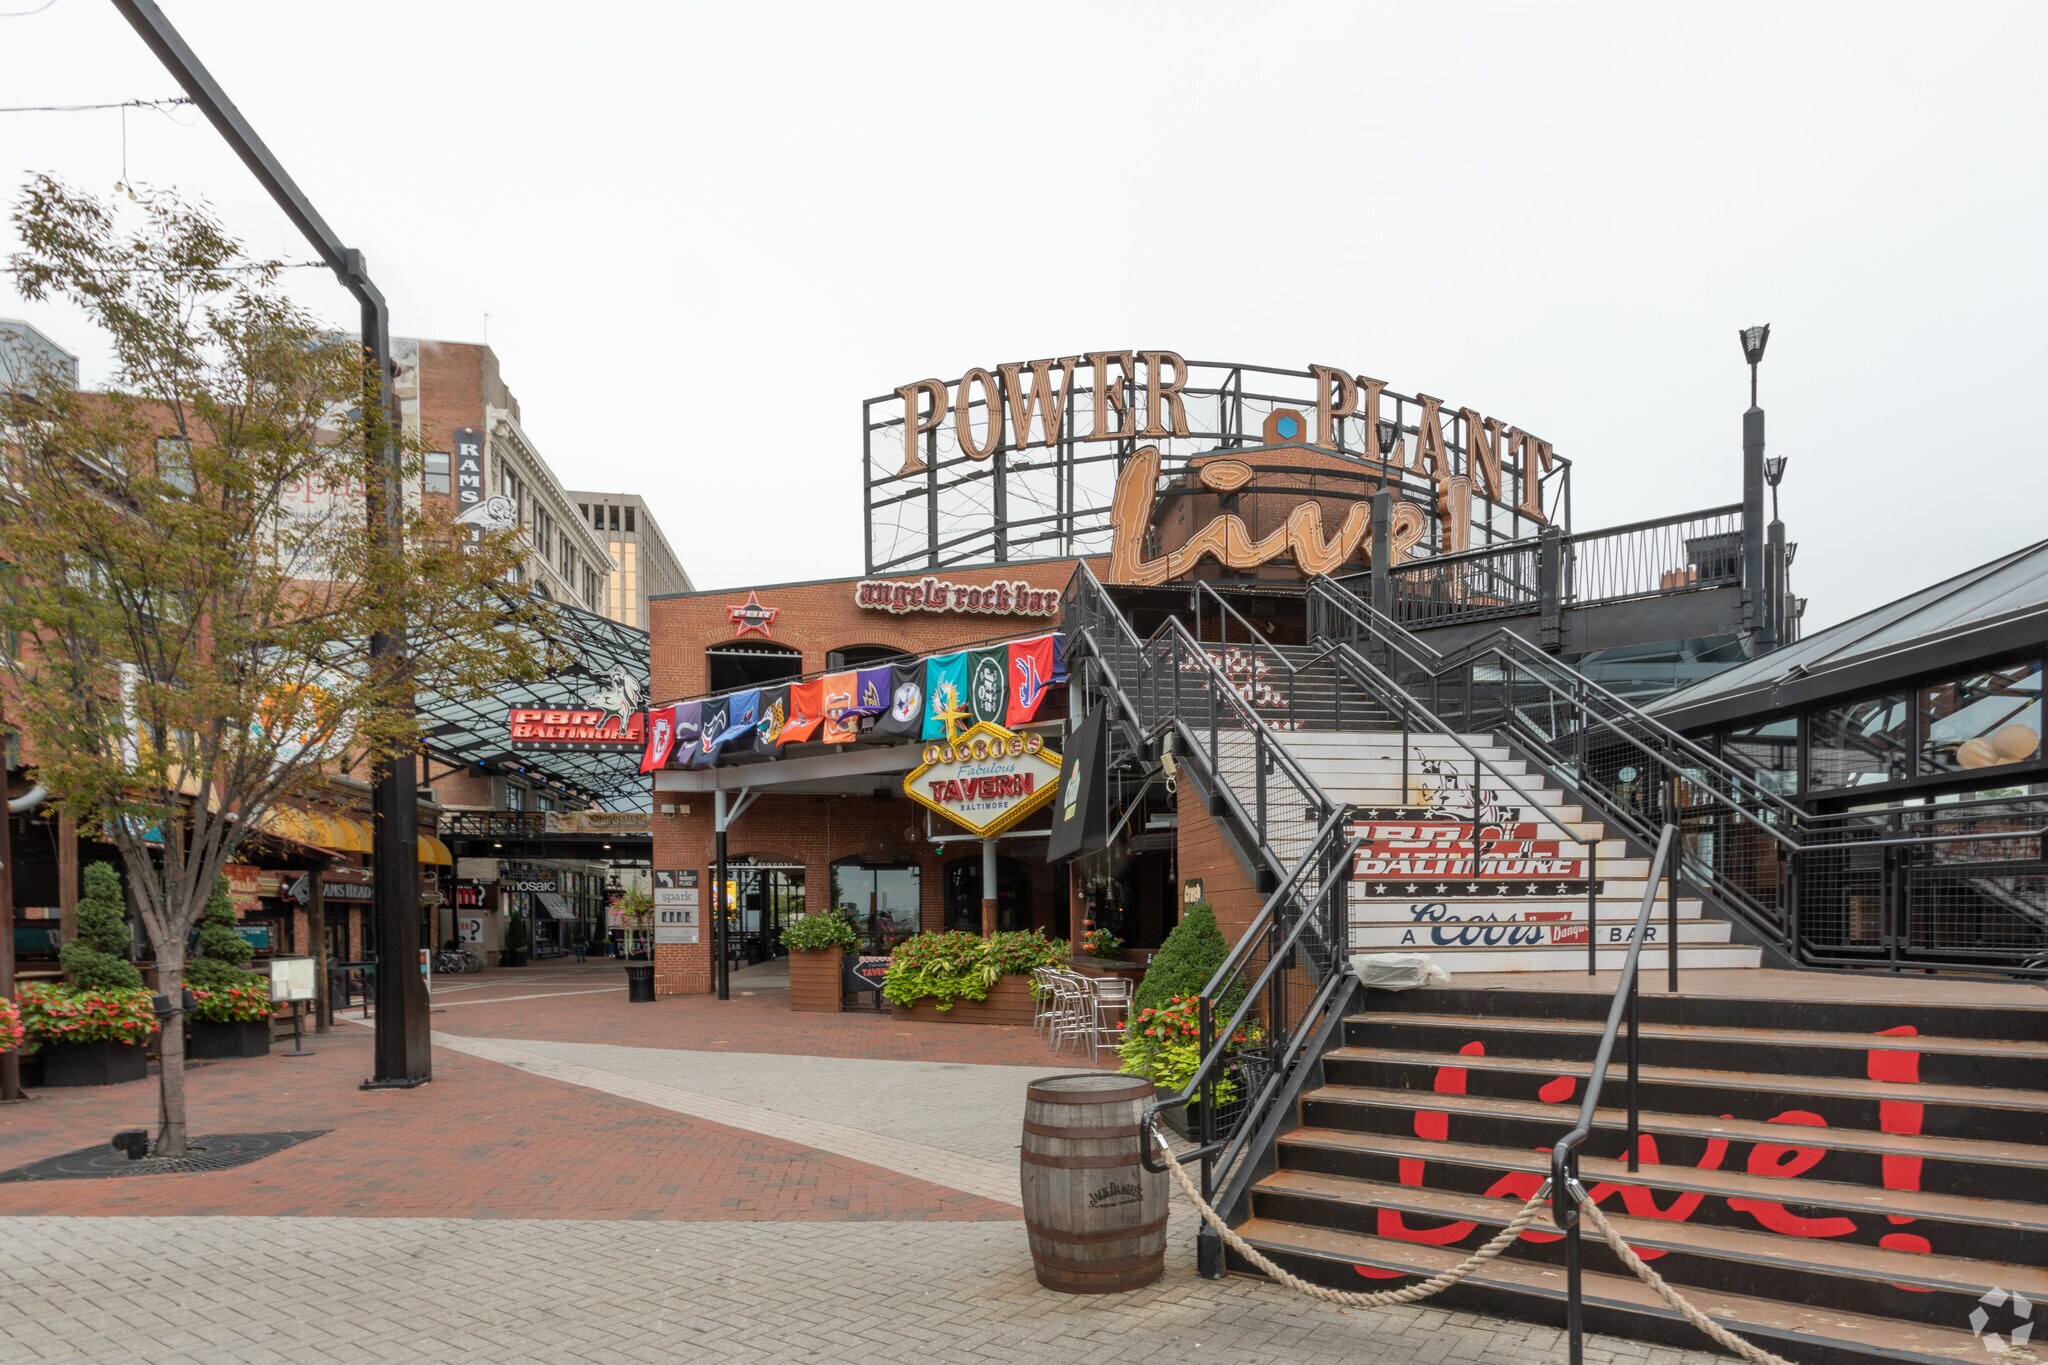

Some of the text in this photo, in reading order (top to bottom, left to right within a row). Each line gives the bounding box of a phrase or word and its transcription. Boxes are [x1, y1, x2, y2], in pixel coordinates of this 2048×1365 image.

[895, 350, 1553, 525] POWER PLANT
[460, 443, 480, 503] RAMS
[859, 579, 1058, 613] angels rock bar
[733, 609, 772, 618] PBR
[984, 667, 994, 712] JETS
[515, 711, 599, 725] PBR
[513, 723, 640, 740] BALTIMORE
[957, 762, 1017, 778] Fabulous
[928, 772, 1035, 803] TAVERN
[960, 802, 1009, 811] BALTIMORE
[323, 883, 372, 898] AMS HEAD
[662, 891, 692, 903] spark
[1401, 929, 1416, 944] A
[1410, 903, 1545, 946] Coors
[862, 967, 887, 977] TAVE
[1088, 1186, 1111, 1206] JACK
